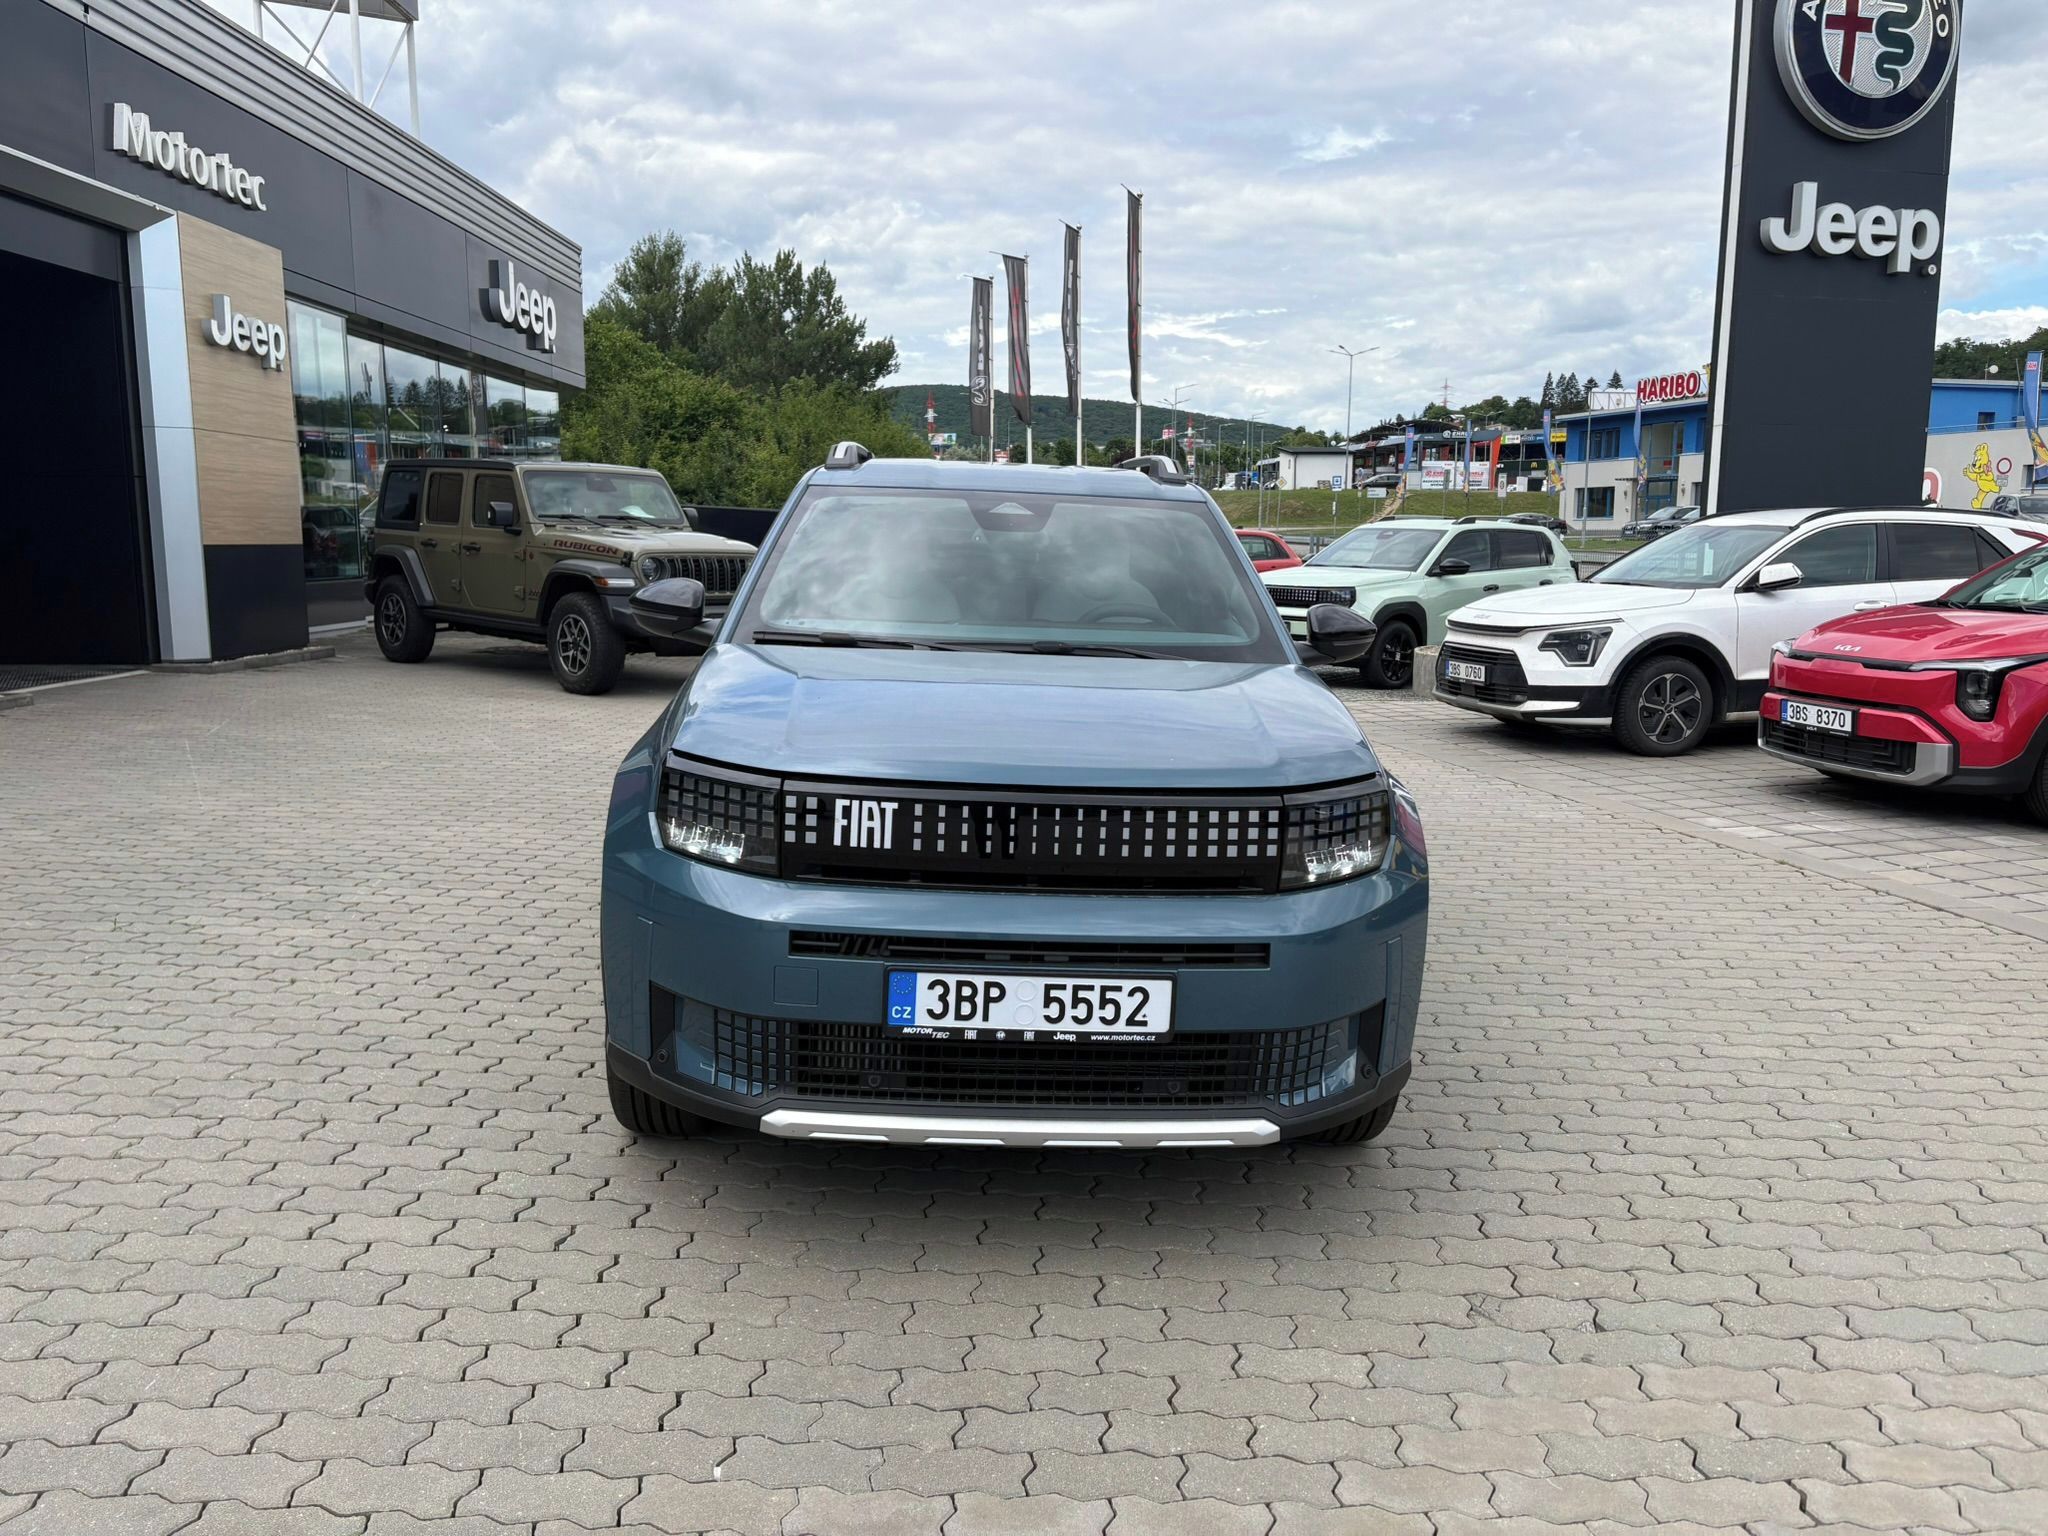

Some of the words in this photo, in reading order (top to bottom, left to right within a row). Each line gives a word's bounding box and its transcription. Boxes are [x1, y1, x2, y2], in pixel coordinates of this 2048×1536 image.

[113, 102, 267, 211] Motortec
[1760, 181, 1940, 274] Jeep
[494, 260, 557, 351] Jeep
[203, 294, 286, 369] Jeep
[1637, 371, 1700, 402] HARIBO
[553, 539, 619, 555] RUBICON
[1789, 704, 1808, 722] 3BS
[1816, 708, 1846, 728] 8370
[833, 798, 898, 849] FIAT
[891, 1005, 912, 1019] CZ
[926, 978, 1007, 1022] 3BP
[1042, 982, 1151, 1027] 5552
[1053, 1032, 1076, 1042] Jeep
[1090, 1033, 1156, 1042] www.motortec.cz
